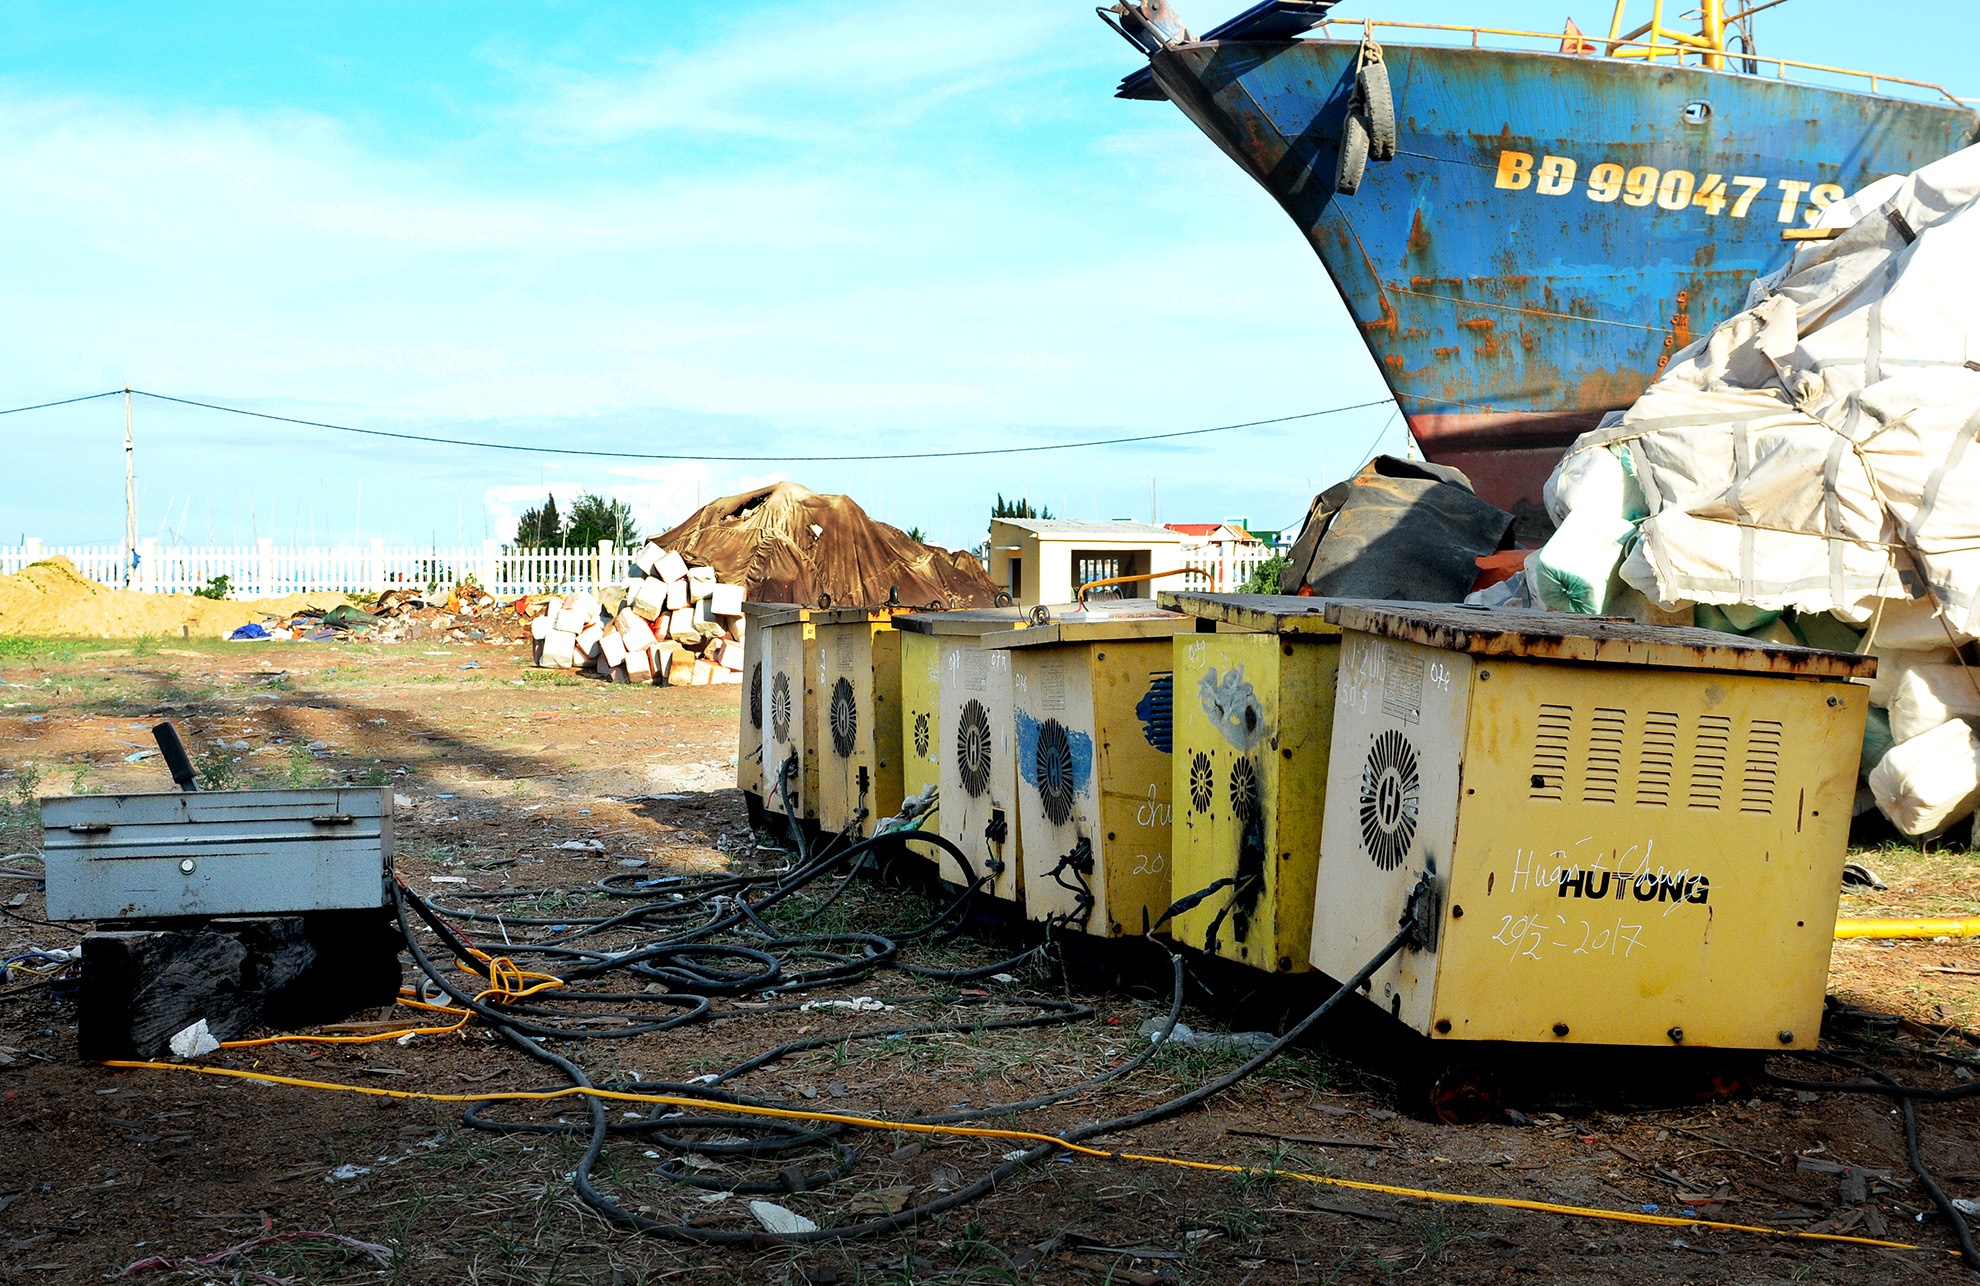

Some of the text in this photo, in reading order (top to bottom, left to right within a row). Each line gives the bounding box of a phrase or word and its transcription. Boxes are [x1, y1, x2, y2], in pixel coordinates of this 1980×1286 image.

[1494, 150, 1845, 226] BĐ 99047 TS
[1557, 869, 1710, 905] HUTONG
